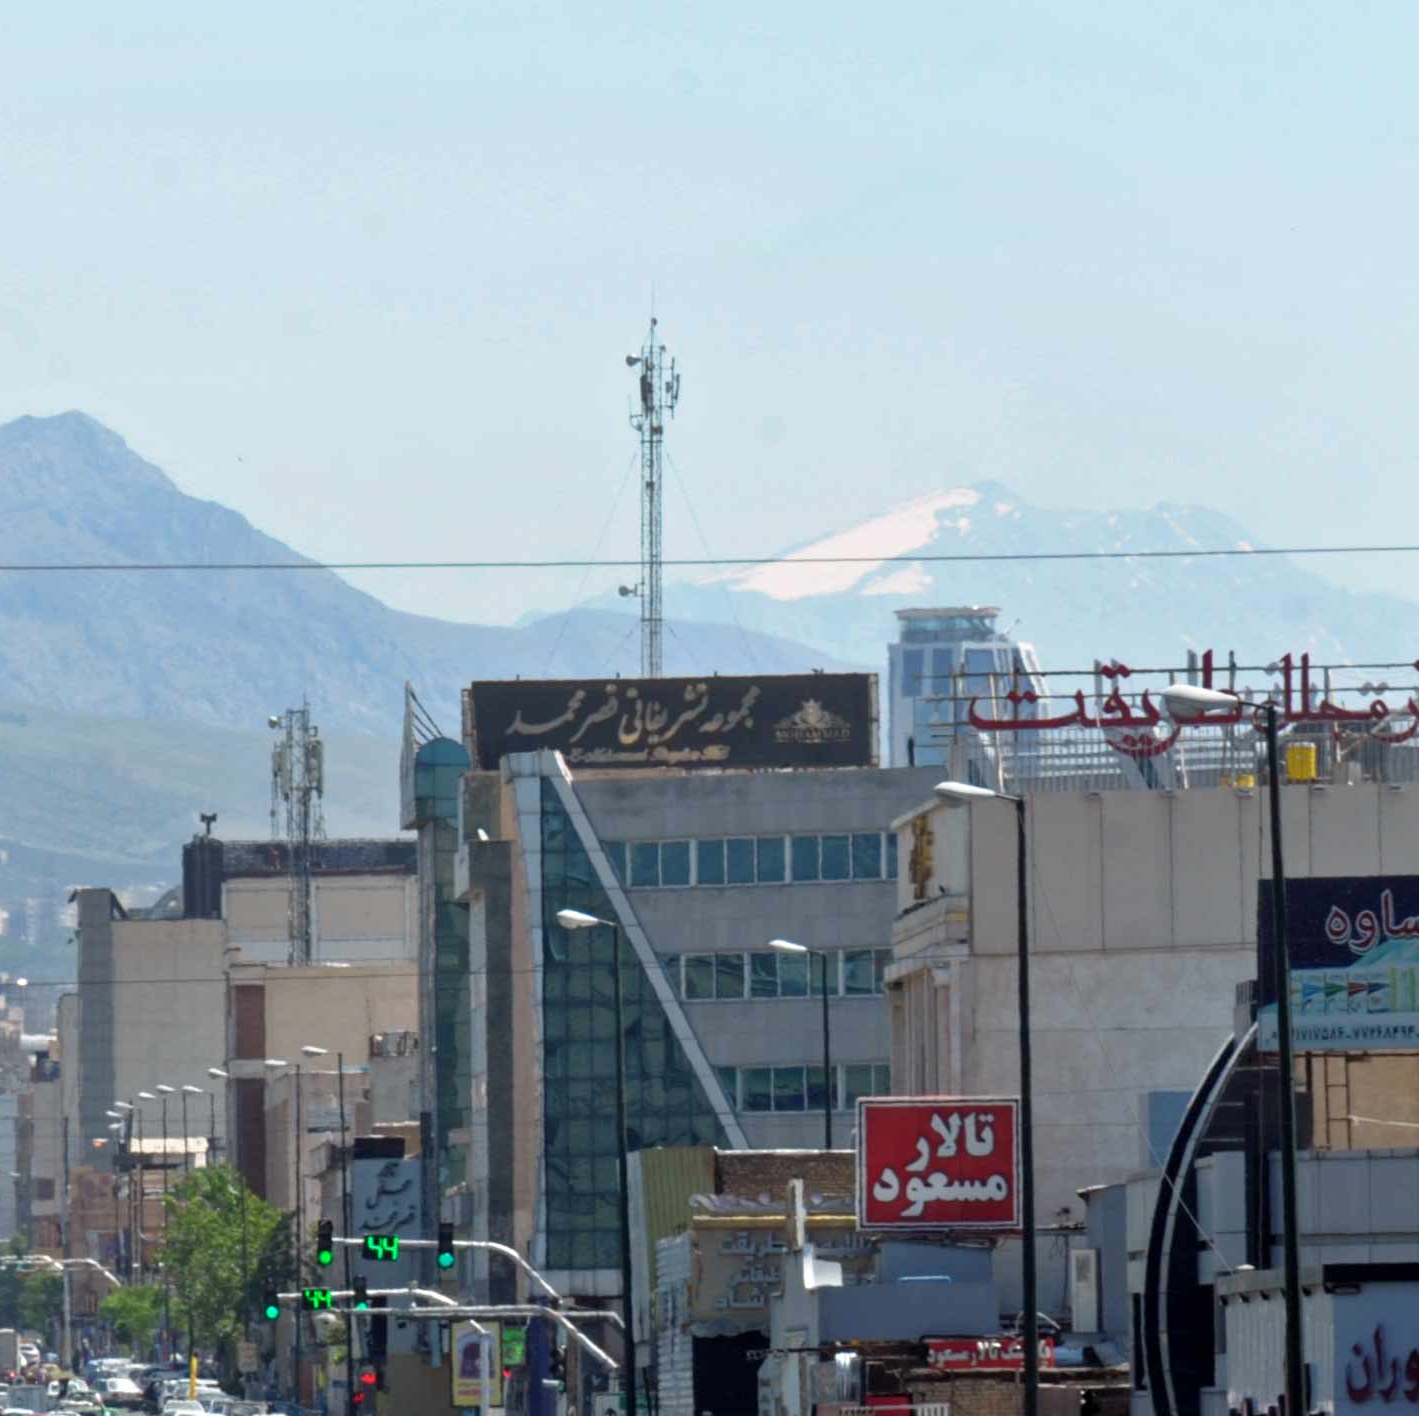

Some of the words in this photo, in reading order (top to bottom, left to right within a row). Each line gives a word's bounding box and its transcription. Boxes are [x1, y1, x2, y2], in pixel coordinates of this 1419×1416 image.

[505, 689, 587, 735] محمد
[905, 1112, 995, 1172] تالار
[873, 1167, 1008, 1217] مسعود
[367, 1235, 400, 1261] 44
[303, 1289, 332, 1309] 44
